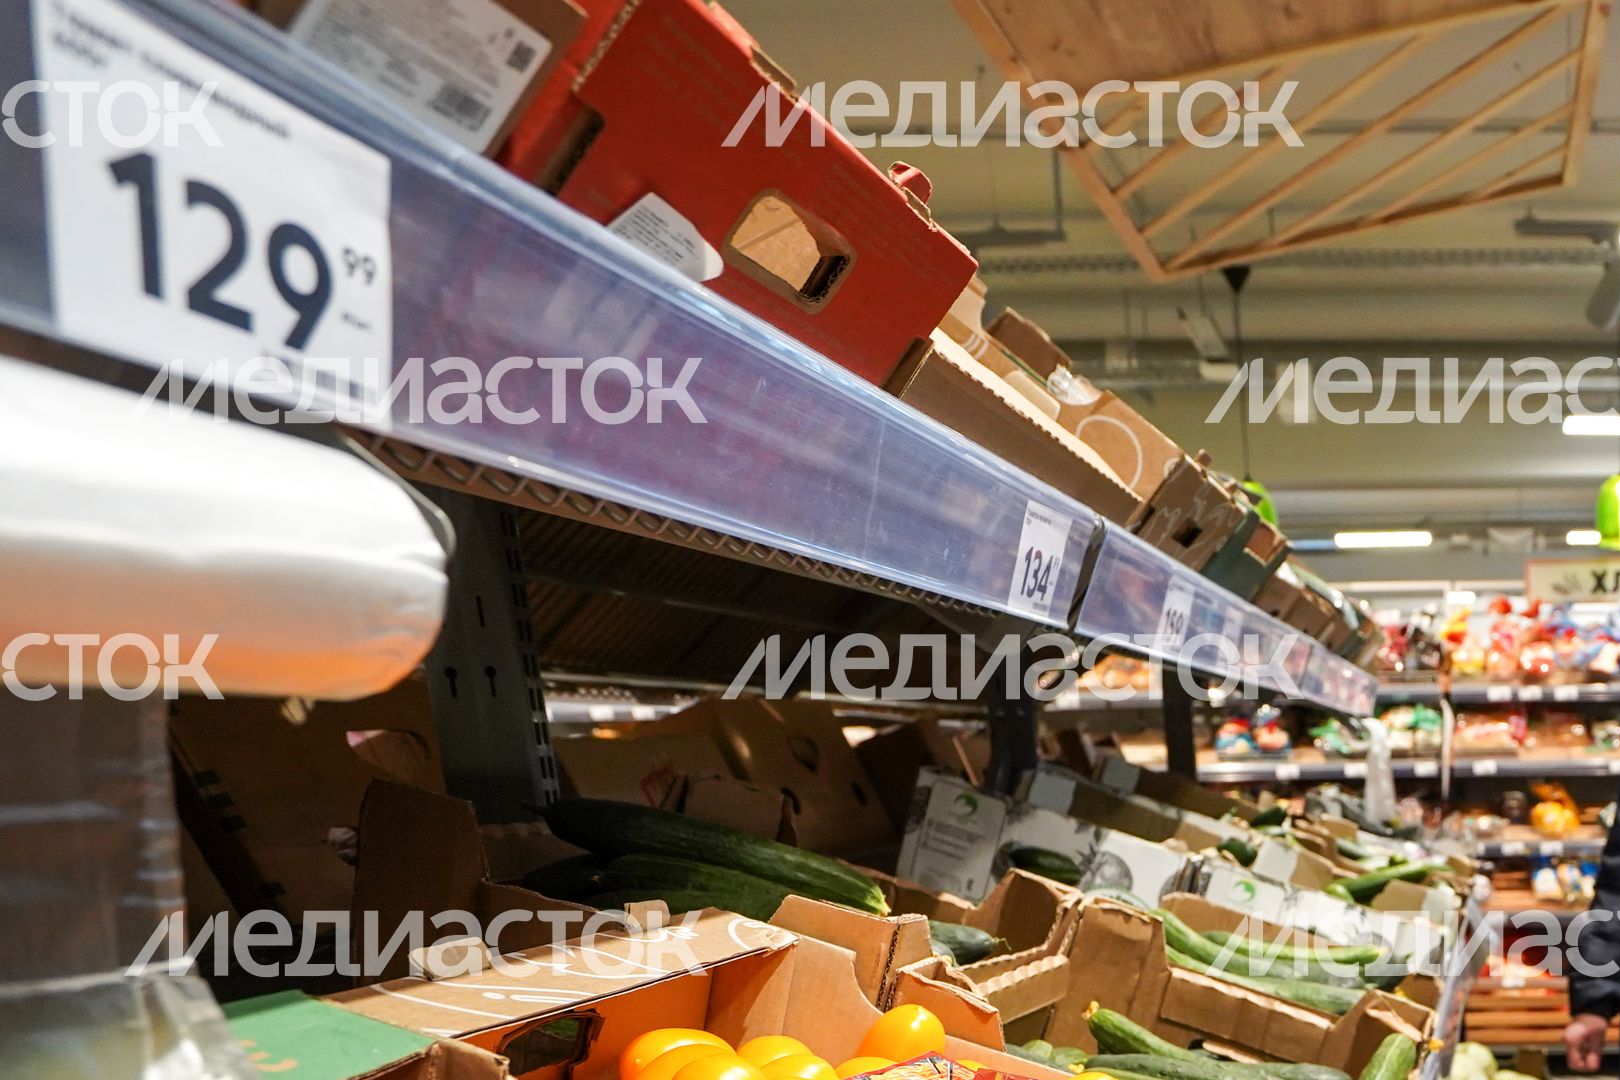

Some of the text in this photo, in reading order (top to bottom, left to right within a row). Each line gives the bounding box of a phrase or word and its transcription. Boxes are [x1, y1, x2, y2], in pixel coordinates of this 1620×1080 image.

[106, 152, 377, 351] 129 99
[1020, 545, 1054, 601] 134
